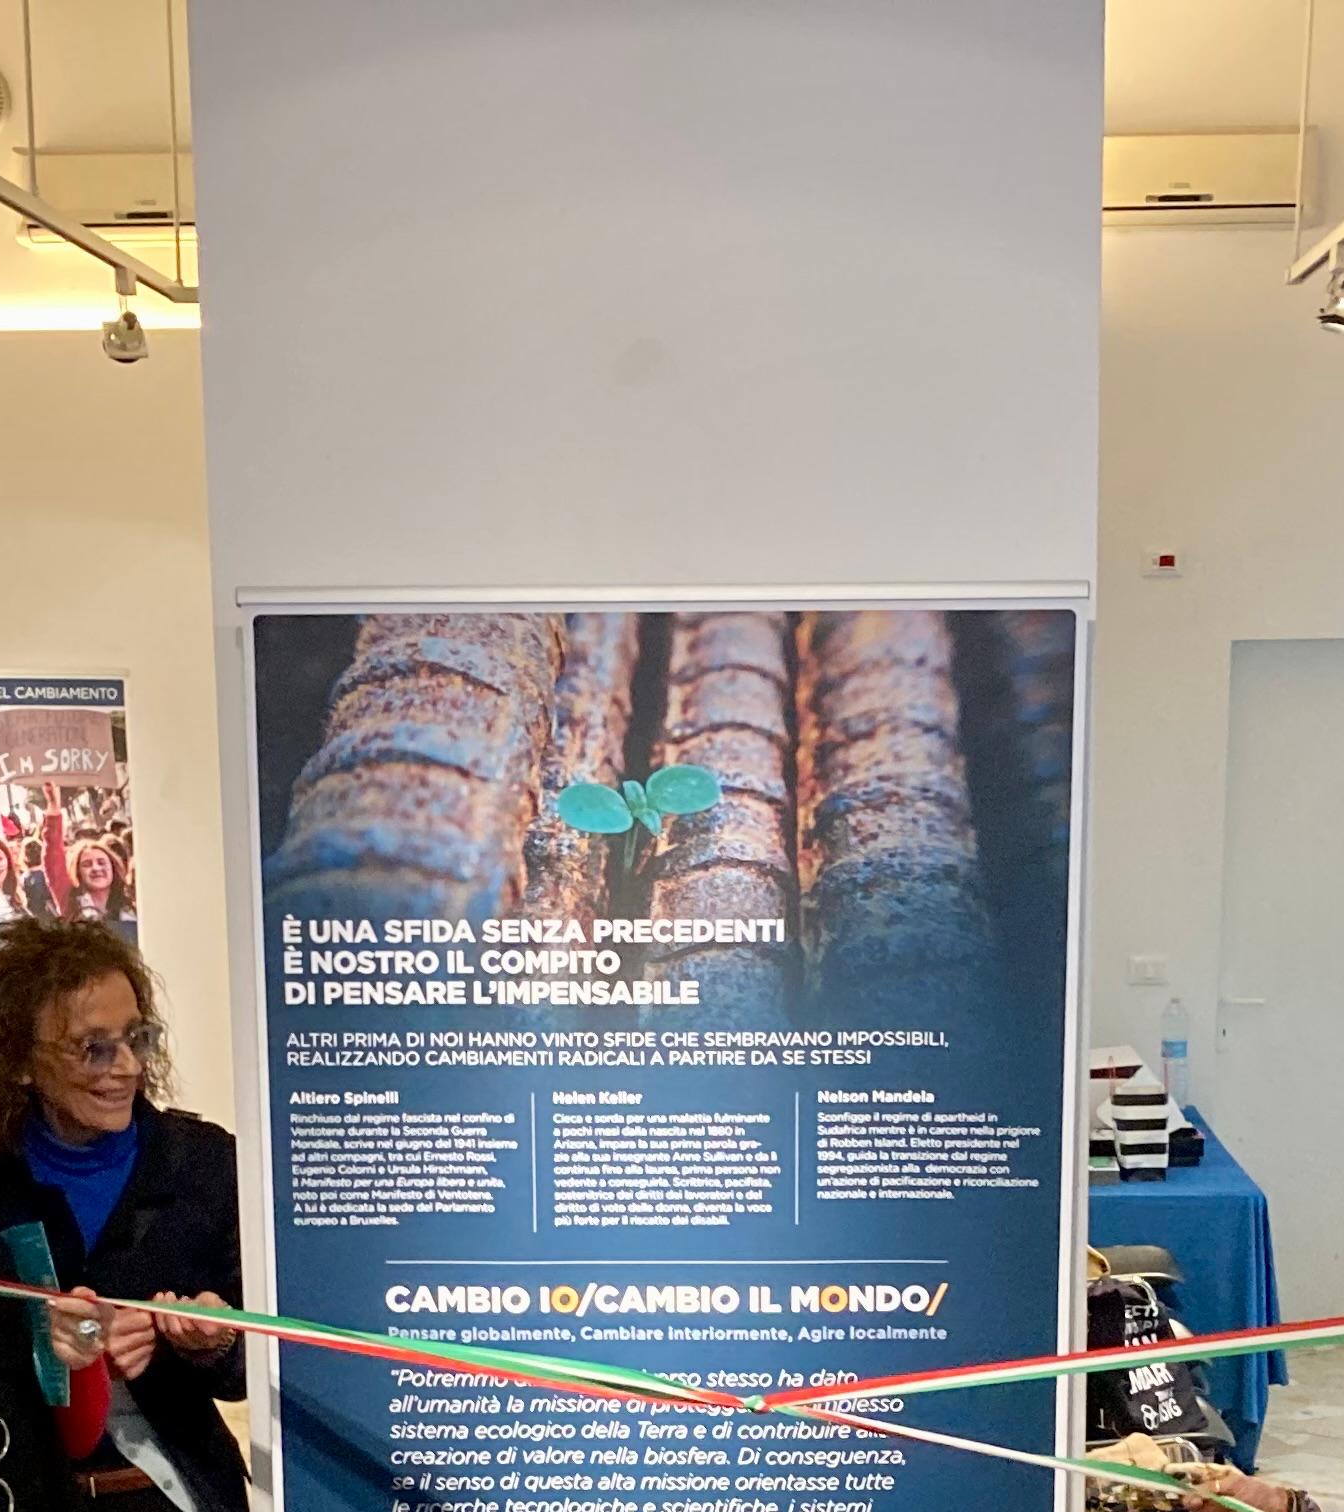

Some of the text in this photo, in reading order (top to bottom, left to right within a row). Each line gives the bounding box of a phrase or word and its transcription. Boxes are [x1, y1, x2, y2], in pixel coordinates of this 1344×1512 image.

[14, 686, 118, 700] CAMBIAMENTO
[41, 748, 109, 773] SORRY
[283, 914, 785, 943] È UNA SFIDA SENZA PRECEDENTI
[284, 945, 621, 975] È NOSTRO IL COMPITO
[285, 980, 700, 1005] DI PENSARE L'IMPENSABILE
[286, 1031, 949, 1048] ALTRI PRIMA DI NOI HANNO VINTO SFIDE CHE SEMBRAVANO IMPOSSIBILI,
[287, 1050, 871, 1066] REALIZZANDO CAMBIAMENTI RADICALI A PARTIRE DA SE STESSI
[289, 1090, 399, 1107] Altiero Spinelli
[552, 1090, 643, 1105] Helen Keller
[817, 1089, 935, 1104] Nelson Mandela
[385, 1281, 949, 1318] CAMBIO IO/CAMBIO IL MONDO/
[460, 1326, 577, 1344] globalmente,
[579, 1325, 665, 1341] Cambiare
[667, 1325, 794, 1343] interiormente,
[797, 1325, 846, 1343] Agire
[849, 1325, 947, 1340] localmente
[706, 1369, 773, 1388] stesso
[777, 1369, 805, 1388] ha
[809, 1369, 859, 1388] dato
[388, 1394, 622, 1414] all'umanità la missione
[389, 1420, 470, 1440] sistema
[474, 1420, 577, 1442] ecologico
[580, 1420, 632, 1440] della
[637, 1420, 689, 1440] Terra
[692, 1424, 708, 1440] e
[711, 1420, 734, 1440] di
[736, 1420, 851, 1440] contribuire
[390, 1446, 906, 1468] creazione di valore nella biosfera. Di conseguenza,
[392, 1471, 895, 1493] se il senso di questa alta missione orientasse tutte
